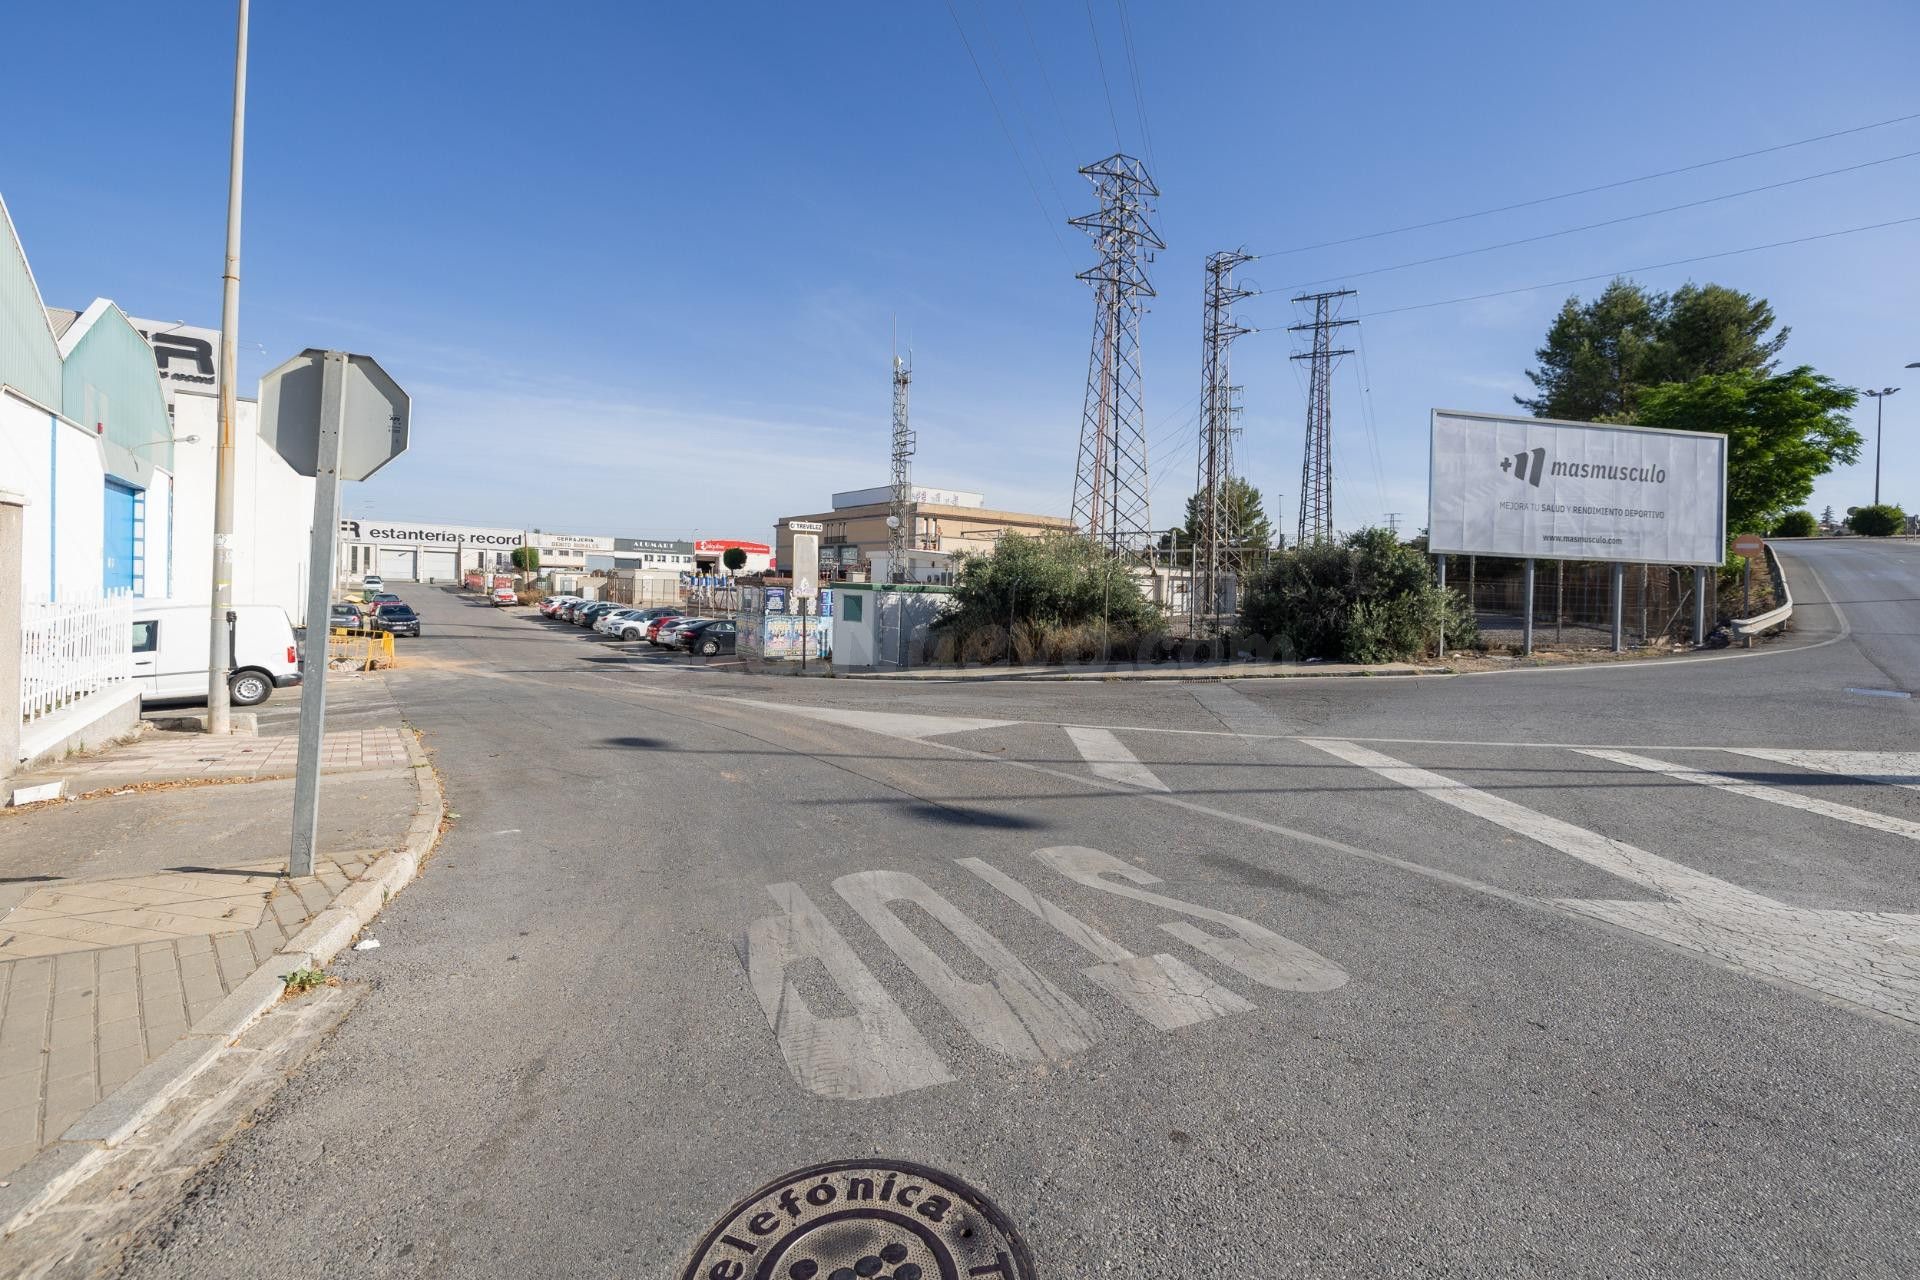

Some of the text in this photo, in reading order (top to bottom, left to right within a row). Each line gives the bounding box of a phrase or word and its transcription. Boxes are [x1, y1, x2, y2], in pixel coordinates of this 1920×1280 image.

[1550, 460, 1666, 484] masmusculo
[1499, 501, 1665, 519] MEJORA TU SALUD Y RENDIMIENTO DEPORTIVO
[797, 523, 822, 531] TREVELEZ
[369, 527, 522, 546] estanterías record
[1542, 533, 1623, 545] www.masmusculo.com
